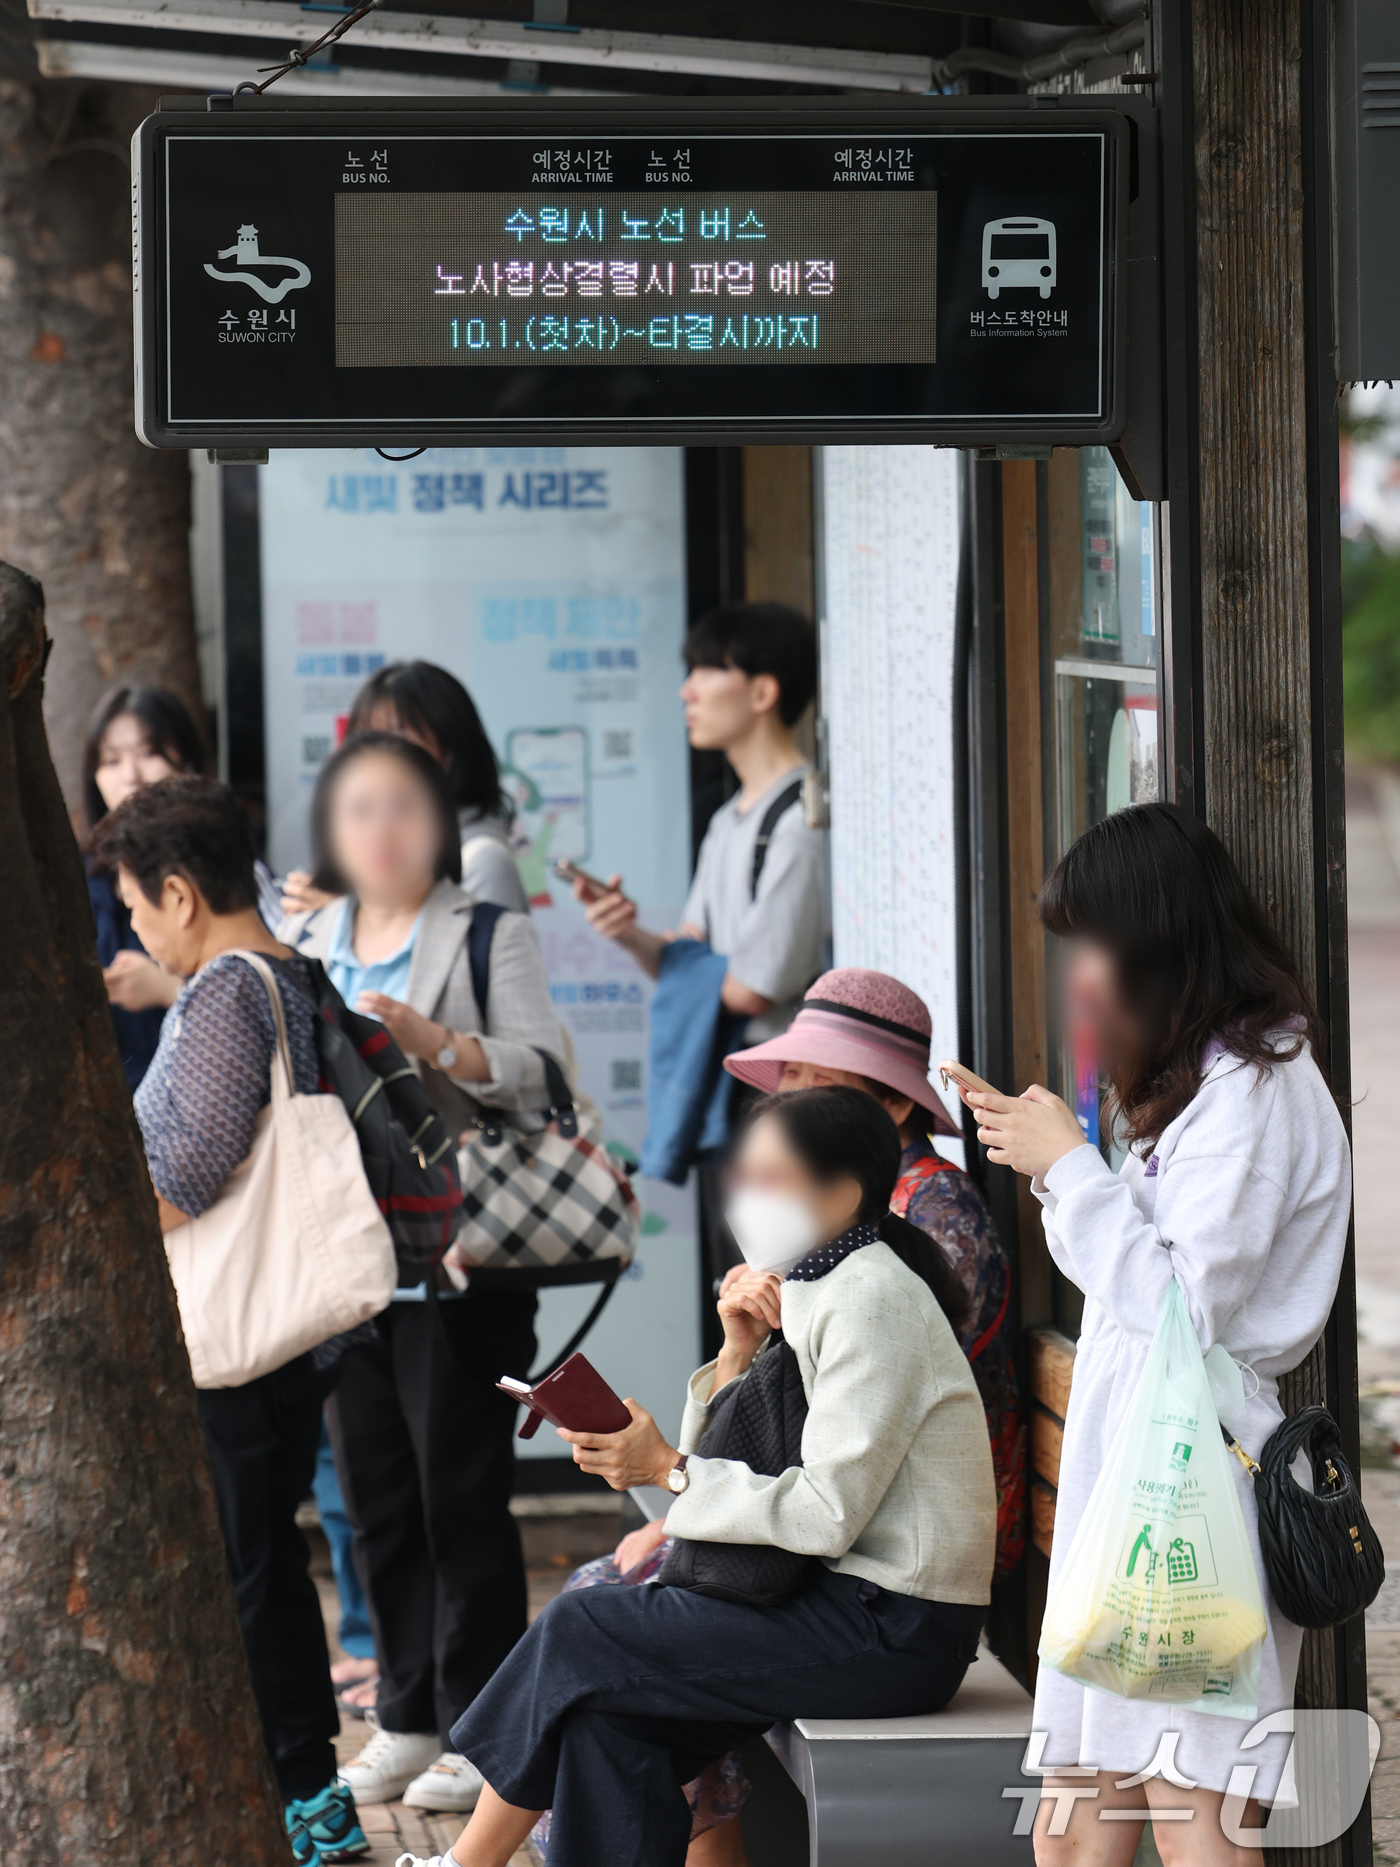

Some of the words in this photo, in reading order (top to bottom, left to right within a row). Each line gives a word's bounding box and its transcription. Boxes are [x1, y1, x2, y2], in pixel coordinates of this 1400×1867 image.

[532, 149, 613, 171] 예정시간
[834, 148, 914, 170] 예정시간
[342, 173, 367, 184] BUS
[369, 173, 391, 184] NO.
[531, 172, 583, 183] ARRIVAL
[584, 172, 613, 183] TIME
[645, 172, 669, 183] BUS
[672, 172, 693, 183] NO.
[833, 171, 884, 182] ARRIVAL
[885, 171, 915, 182] TIME
[504, 208, 604, 242] 수원시
[620, 208, 685, 242] 노선
[699, 207, 767, 241] 버스
[434, 260, 675, 297] 노사협상결렬시
[690, 261, 755, 296] 파업
[769, 260, 836, 296] 예정
[218, 309, 297, 331] 수원시
[970, 309, 1068, 328] 버스도착안내
[217, 332, 265, 343] SUWON
[267, 332, 297, 343] CITY
[970, 328, 987, 338] Bus
[988, 328, 1035, 338] Information
[1037, 328, 1068, 339] System
[326, 472, 397, 512] 새빛
[411, 471, 485, 512] 정책
[498, 469, 609, 511] 시리즈
